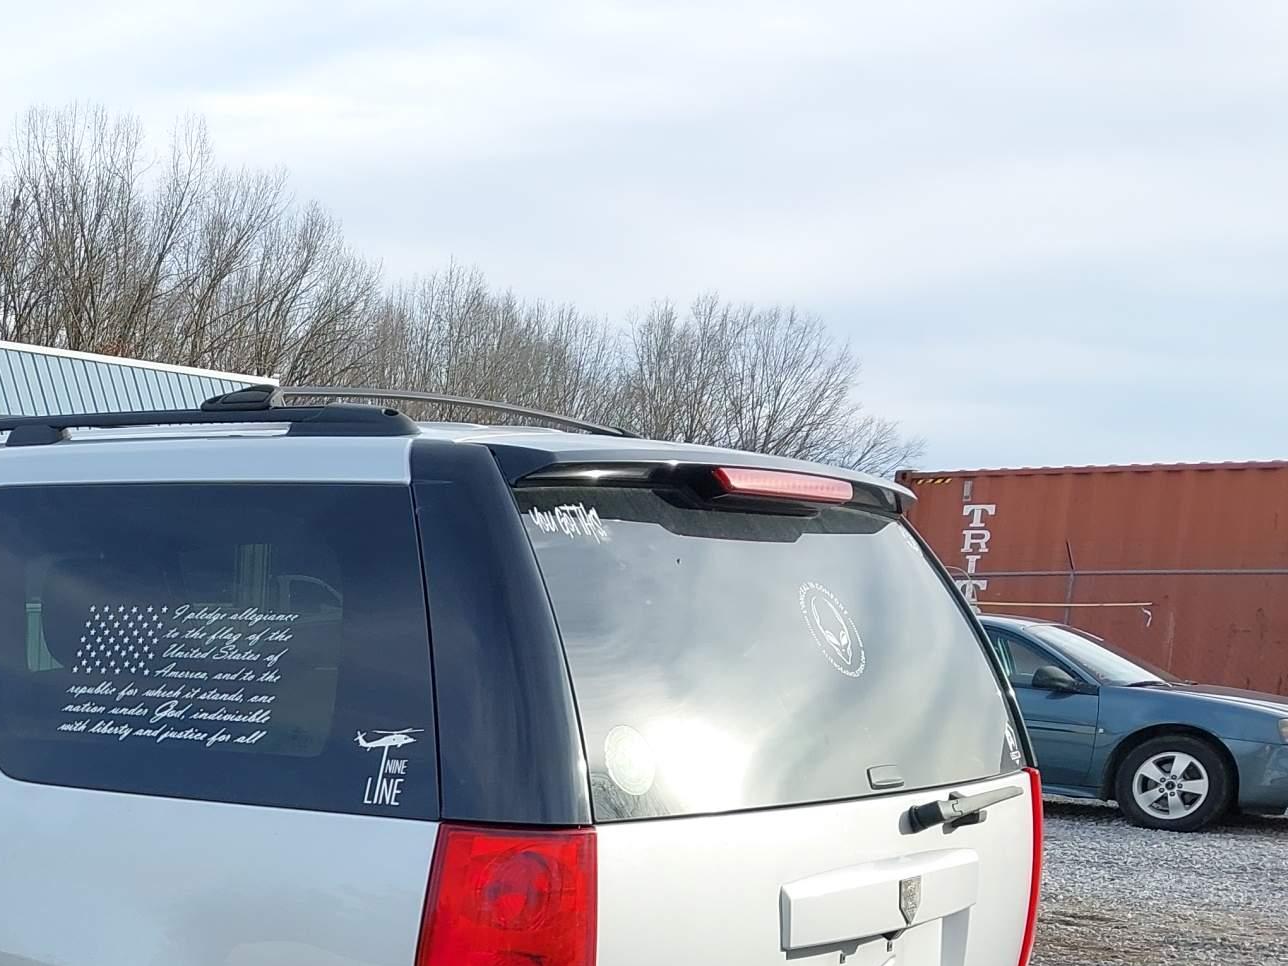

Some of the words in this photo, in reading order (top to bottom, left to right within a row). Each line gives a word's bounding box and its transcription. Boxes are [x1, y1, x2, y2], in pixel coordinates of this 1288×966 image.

[955, 503, 997, 614] TRIT
[172, 604, 191, 620] I
[182, 606, 228, 626] pledge
[228, 607, 300, 627] allegiance
[163, 627, 180, 639] to
[181, 626, 207, 640] the
[205, 626, 242, 646] flag
[245, 627, 271, 646] of
[264, 627, 294, 642] the
[162, 643, 217, 660] United
[212, 644, 261, 661] States
[263, 648, 289, 667] of
[153, 662, 209, 681] America,
[212, 668, 246, 681] and
[239, 670, 256, 682] to
[256, 668, 281, 683] the
[65, 681, 117, 698] republic
[115, 682, 138, 701] for
[141, 684, 186, 699] which
[183, 687, 201, 699] it
[197, 687, 245, 704] stands,
[247, 694, 276, 704] one
[62, 701, 106, 713] nation
[107, 702, 149, 716] under
[149, 700, 193, 724] God,
[189, 706, 272, 724] indivisible
[57, 719, 91, 732] with
[88, 720, 134, 741] liberty
[132, 724, 167, 738] and
[156, 727, 209, 744] justice
[206, 728, 232, 748] for
[233, 731, 268, 745] all
[384, 759, 409, 775] NINE
[362, 777, 405, 806] LINE
